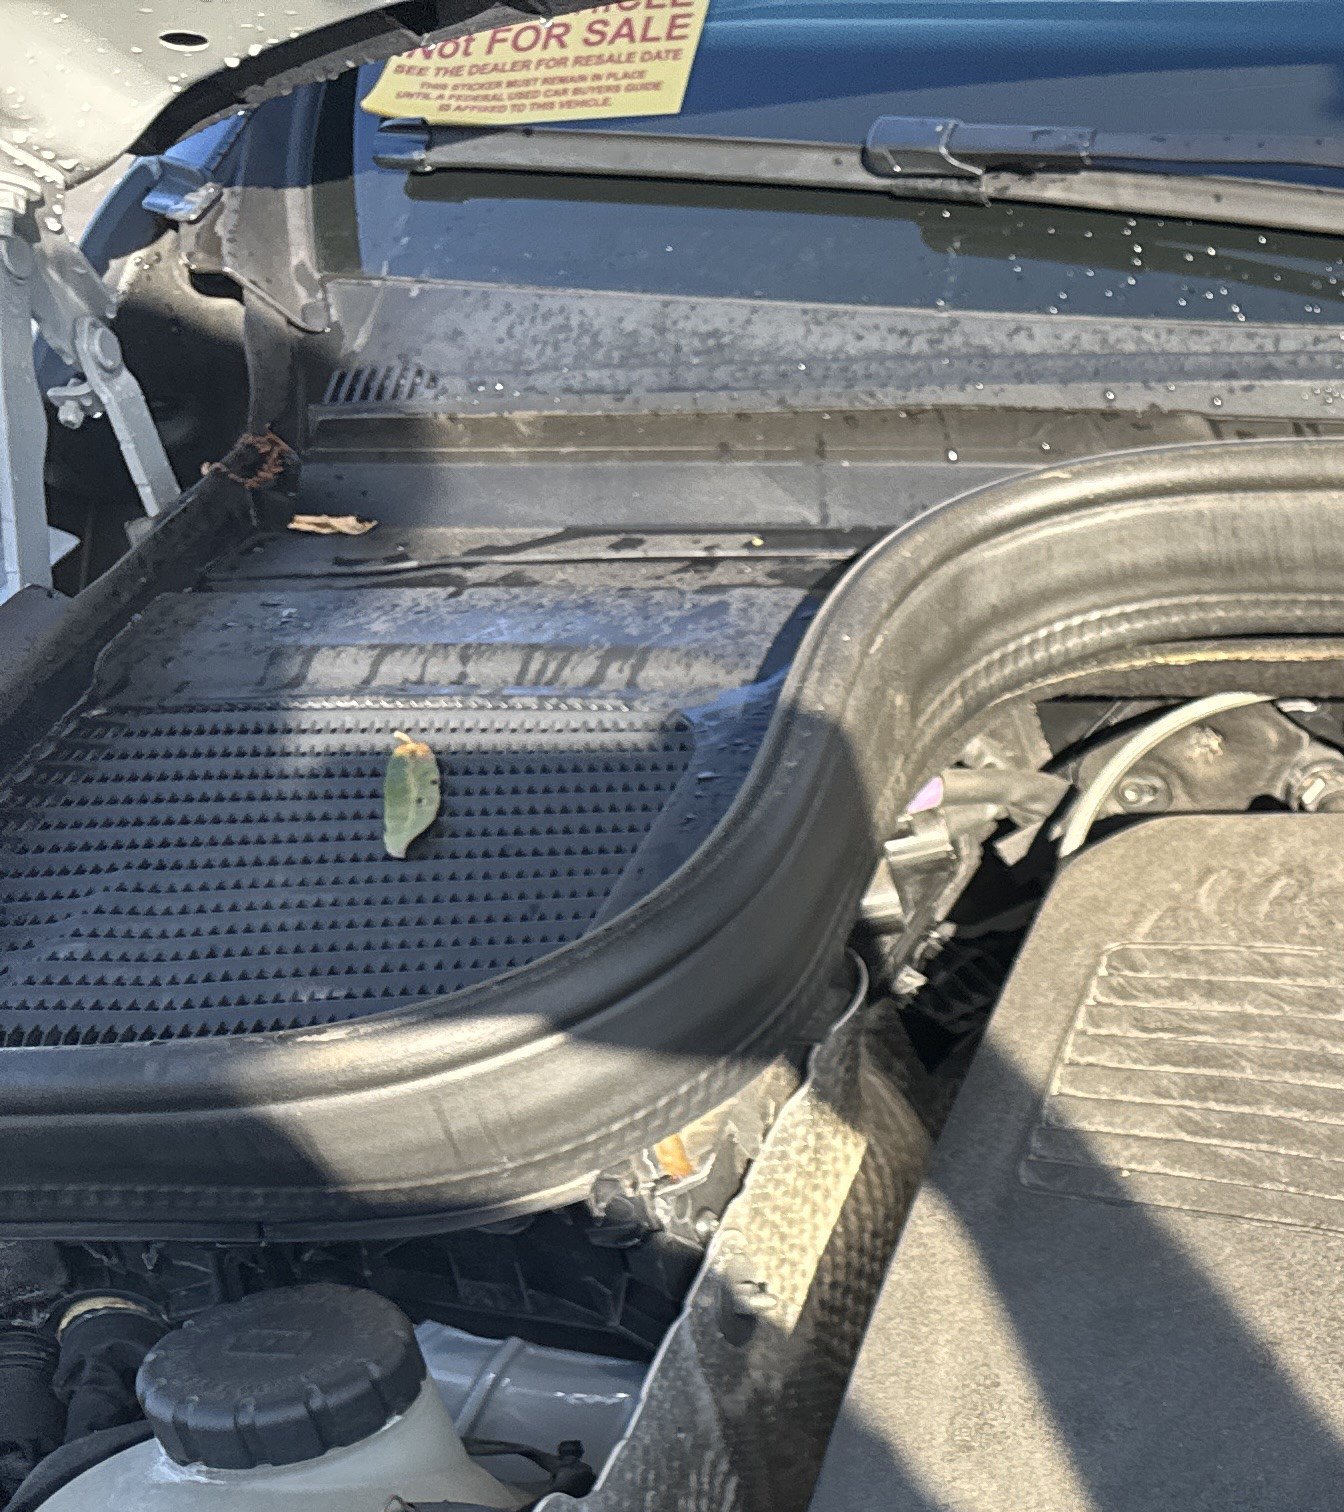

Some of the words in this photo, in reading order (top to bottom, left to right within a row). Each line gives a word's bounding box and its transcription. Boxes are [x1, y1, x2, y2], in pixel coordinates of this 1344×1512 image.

[485, 23, 571, 55] FOR
[583, 13, 694, 47] SALE
[394, 64, 429, 77] SEE
[434, 64, 464, 77] THE
[467, 59, 532, 76] DEALER
[535, 56, 569, 70] FOR
[572, 51, 636, 67] RESALE
[640, 48, 683, 62] DATE
[605, 70, 646, 81] PLACE
